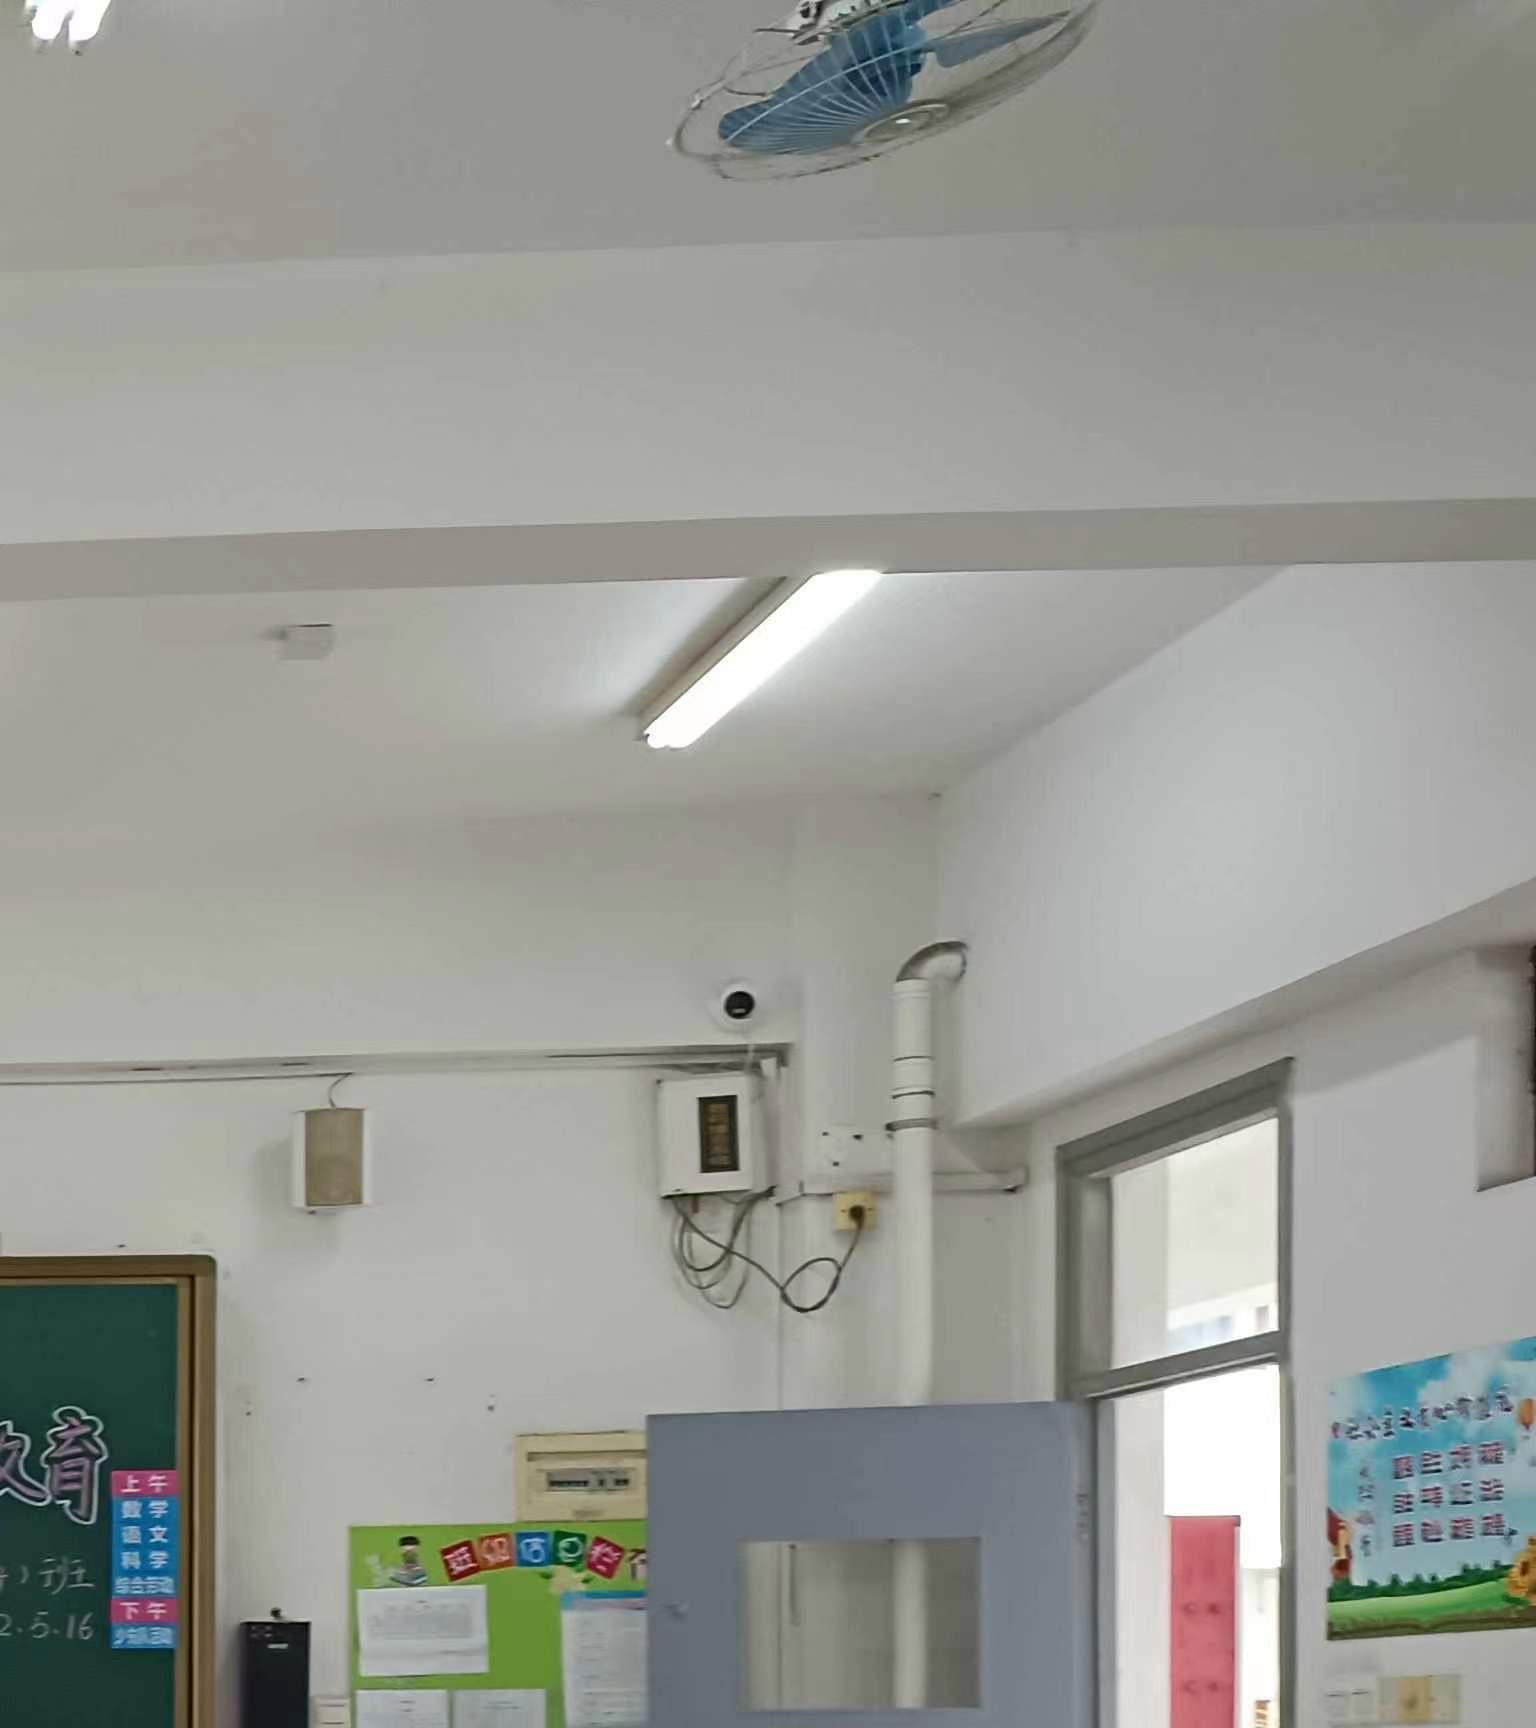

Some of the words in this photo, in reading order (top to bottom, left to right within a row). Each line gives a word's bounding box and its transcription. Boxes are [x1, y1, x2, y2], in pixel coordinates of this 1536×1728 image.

[121, 1474, 169, 1493] 上午
[121, 1525, 169, 1544] 语文
[119, 1602, 168, 1620] 下午
